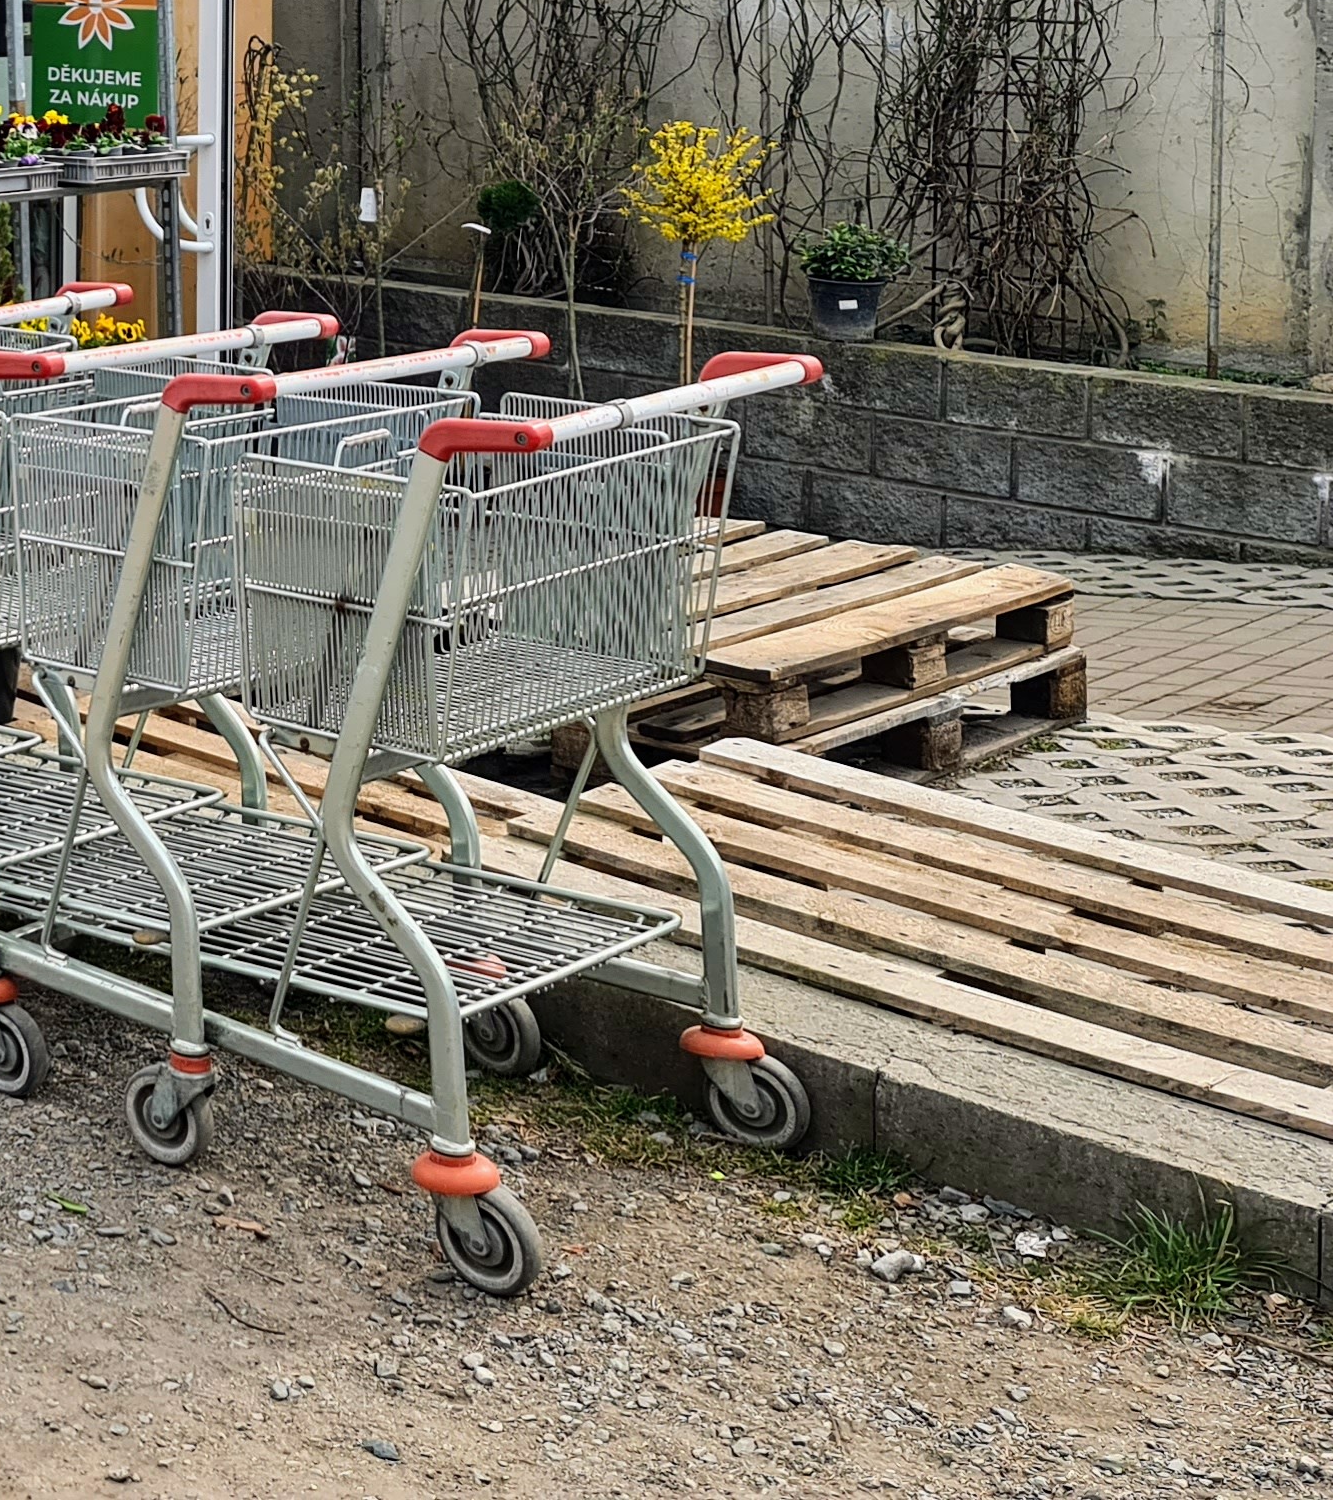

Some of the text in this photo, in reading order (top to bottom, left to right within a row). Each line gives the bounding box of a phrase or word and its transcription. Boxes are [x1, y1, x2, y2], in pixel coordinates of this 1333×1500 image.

[48, 63, 142, 87] DĚKUJEME
[49, 88, 139, 108] ZA NÁKUP
